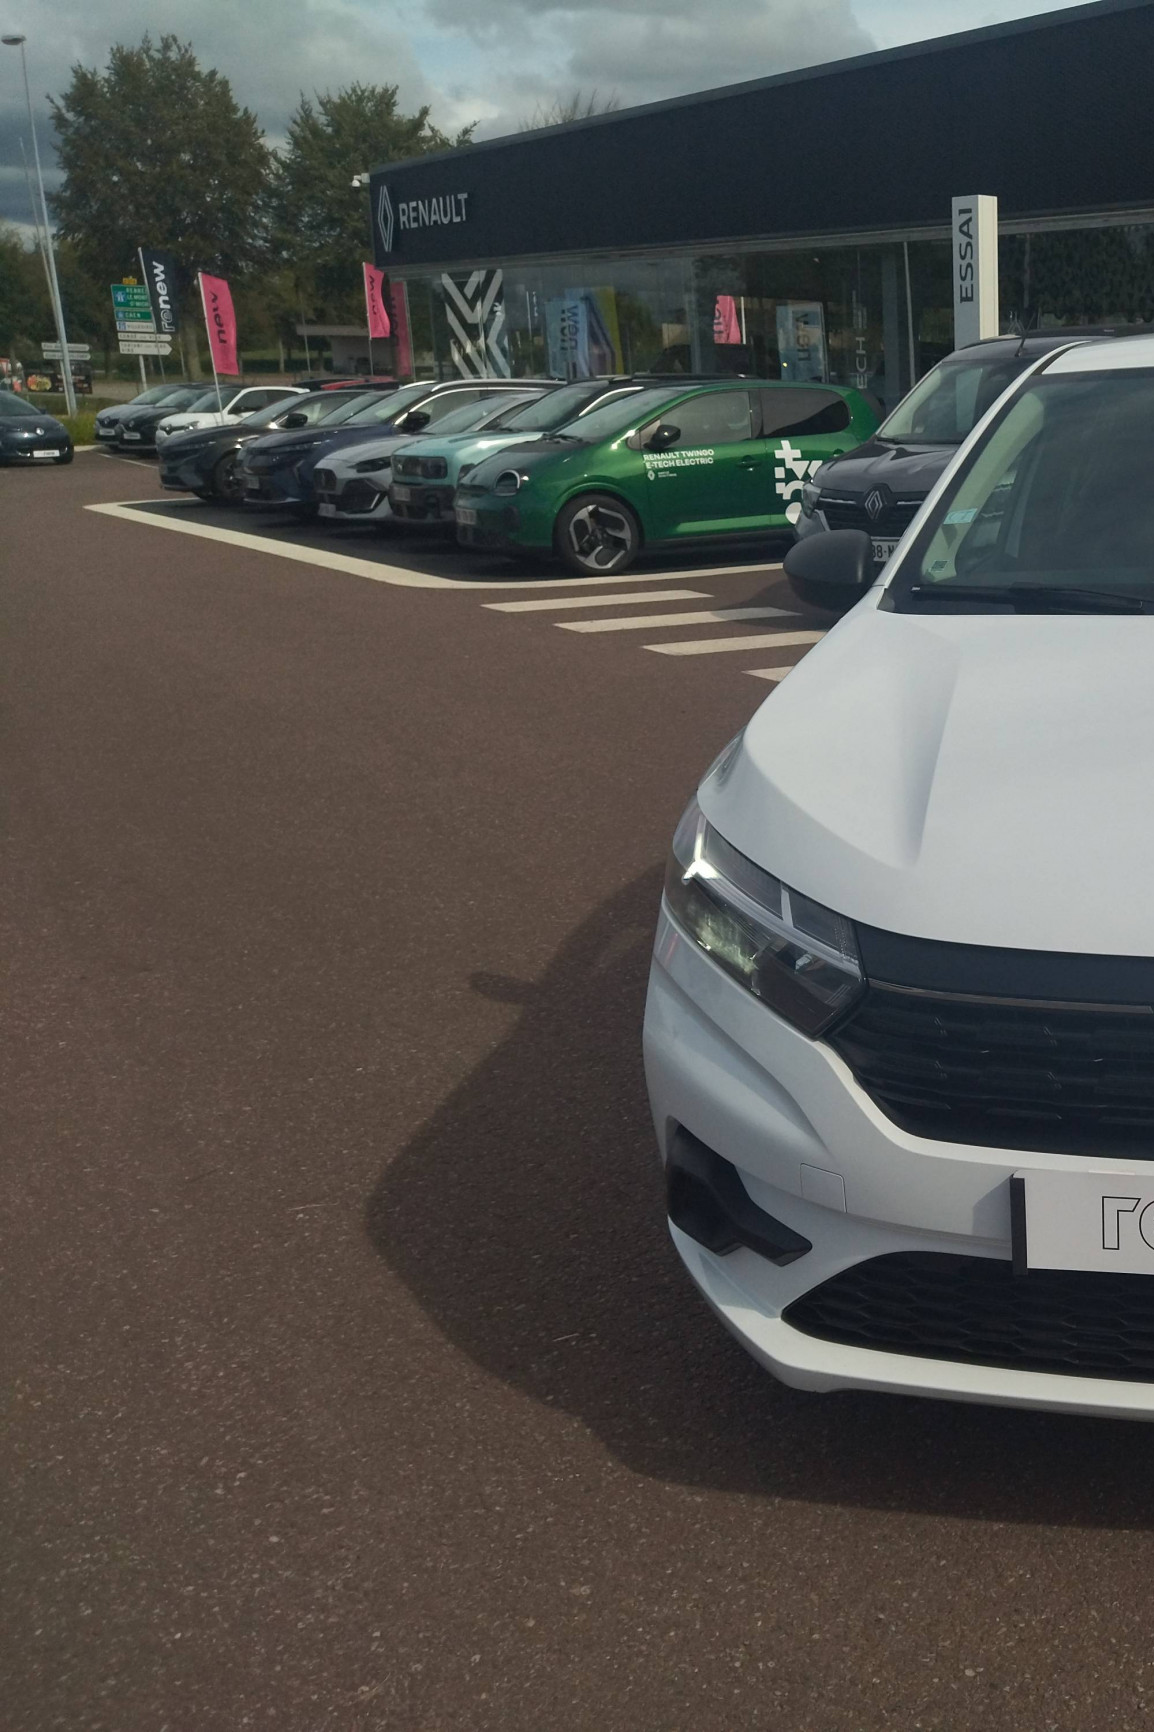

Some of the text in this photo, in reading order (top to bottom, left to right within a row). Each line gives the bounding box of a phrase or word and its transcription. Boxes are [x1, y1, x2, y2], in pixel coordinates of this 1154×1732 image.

[399, 192, 468, 230] RENAULT
[958, 207, 974, 304] ESSAI
[152, 261, 175, 332] renew
[643, 449, 714, 461] RENAULT TWINGO
[646, 457, 714, 469] E-TECH ELECTRIC
